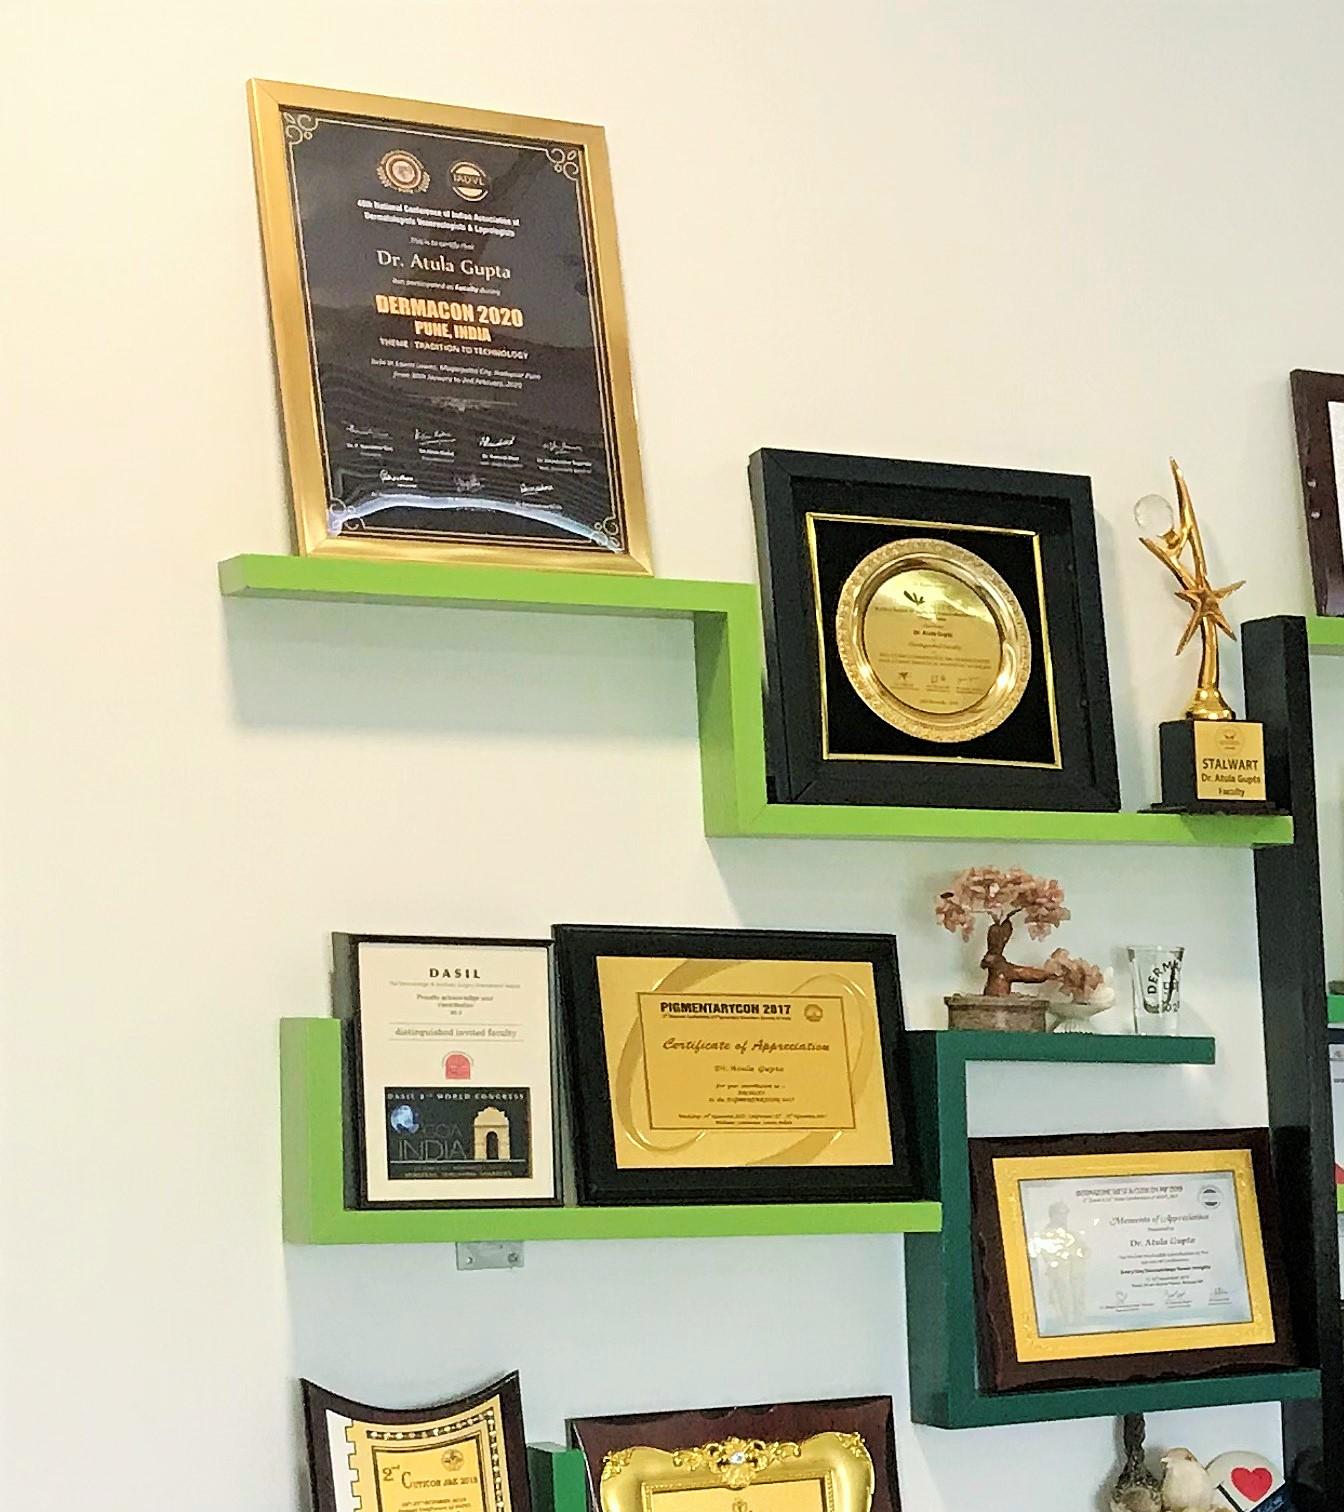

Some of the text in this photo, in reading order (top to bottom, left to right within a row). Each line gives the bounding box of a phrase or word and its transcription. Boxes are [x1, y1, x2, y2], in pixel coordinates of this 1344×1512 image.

[377, 250, 511, 281] Dr. Atula Gupta
[375, 294, 524, 328] DERMACON 2020
[454, 324, 492, 342] INDIA
[1202, 758, 1258, 771] STALWART
[1215, 774, 1235, 783] Atula
[1238, 774, 1261, 784] Gupta
[429, 968, 481, 979] DASIL
[661, 1002, 791, 1015] PIGMENTARYCON 2017
[663, 1037, 830, 1054] Certificate of Appreciation
[400, 1140, 467, 1160] INDIA
